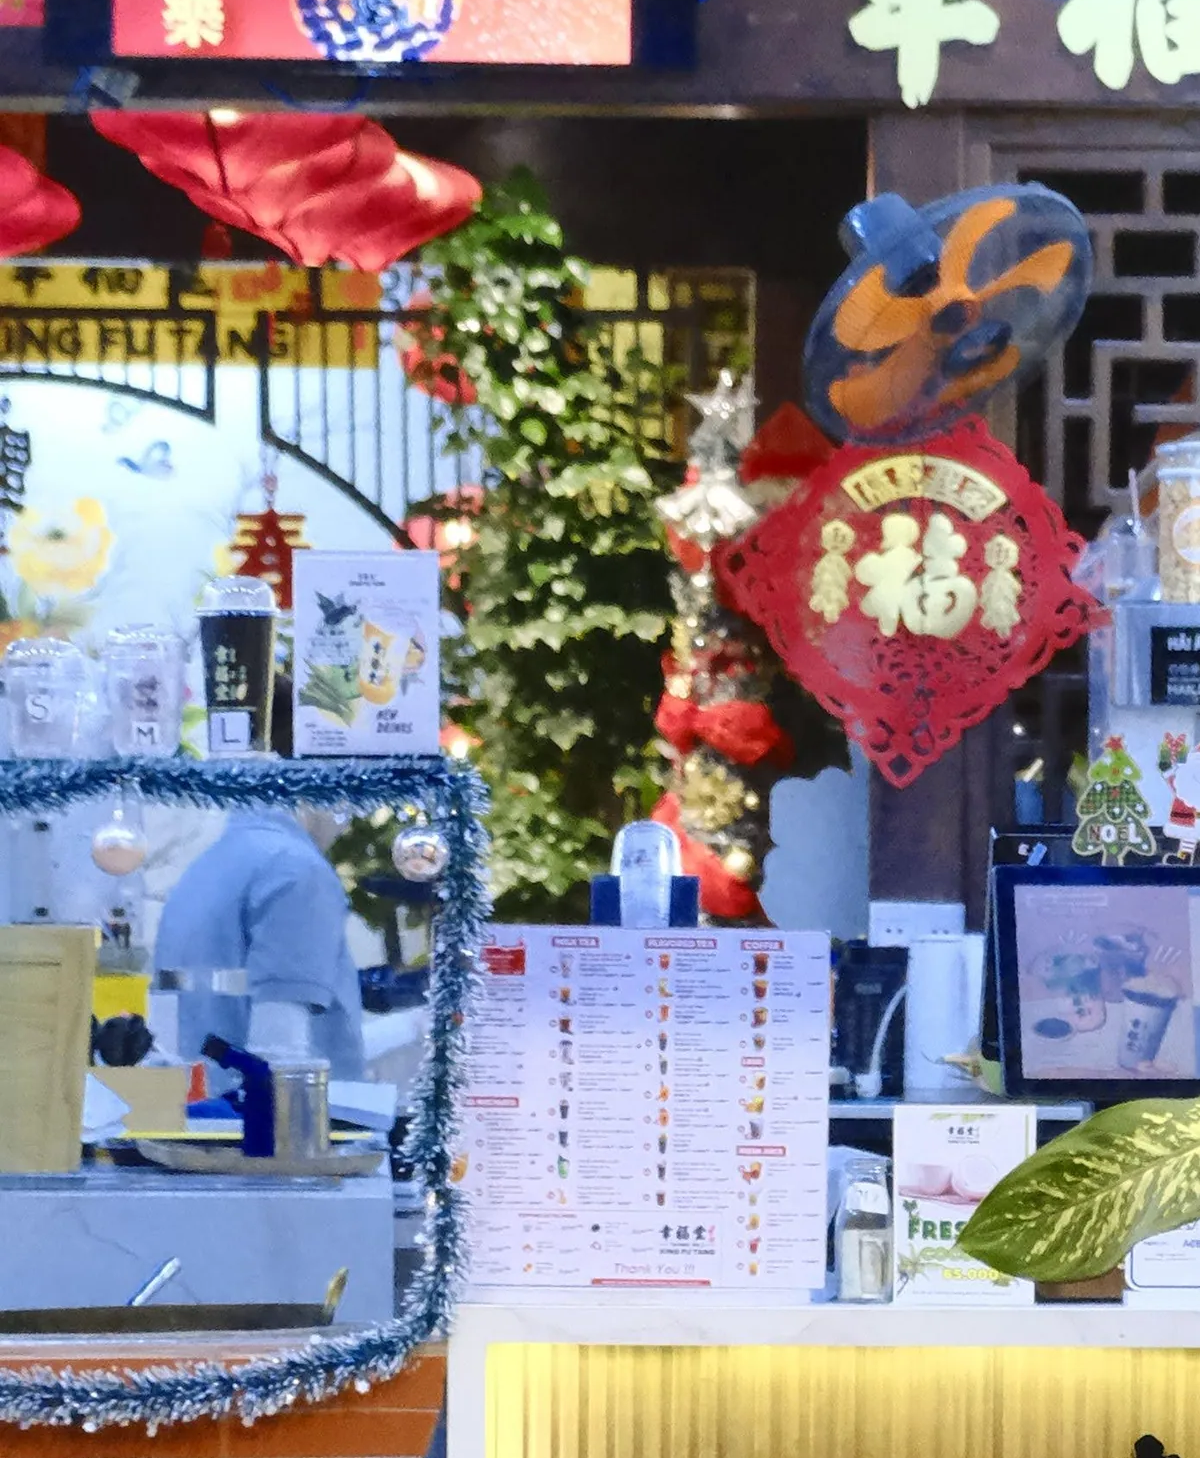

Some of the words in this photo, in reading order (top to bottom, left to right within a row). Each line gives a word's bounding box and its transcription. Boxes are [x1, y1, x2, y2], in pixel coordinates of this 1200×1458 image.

[136, 726, 156, 745] M
[221, 718, 241, 743] L
[1087, 822, 1143, 844] NOEL
